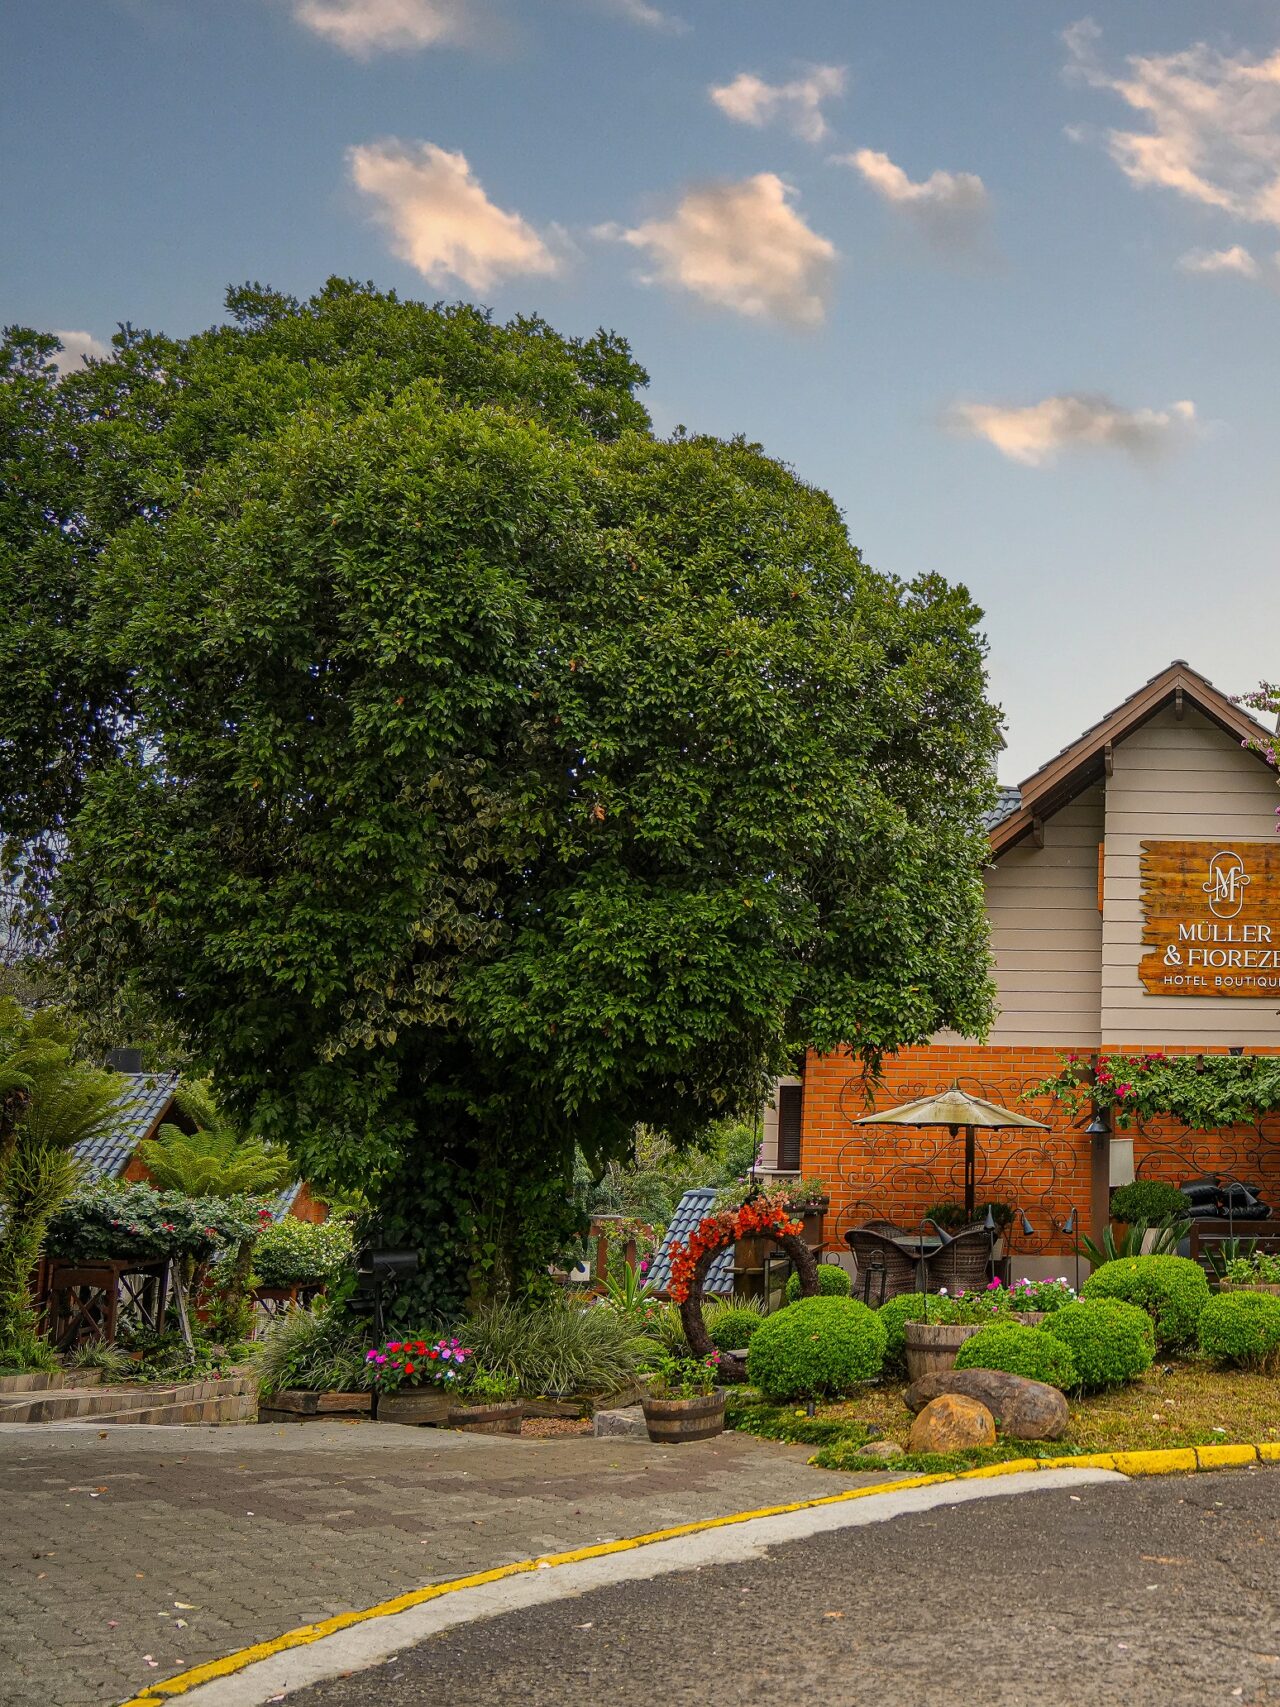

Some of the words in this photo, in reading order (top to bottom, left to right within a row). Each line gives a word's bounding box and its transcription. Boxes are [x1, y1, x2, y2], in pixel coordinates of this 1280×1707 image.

[1178, 921, 1272, 943] MÜLLER
[1163, 945, 1183, 966] &
[1164, 975, 1207, 986] HOTEL
